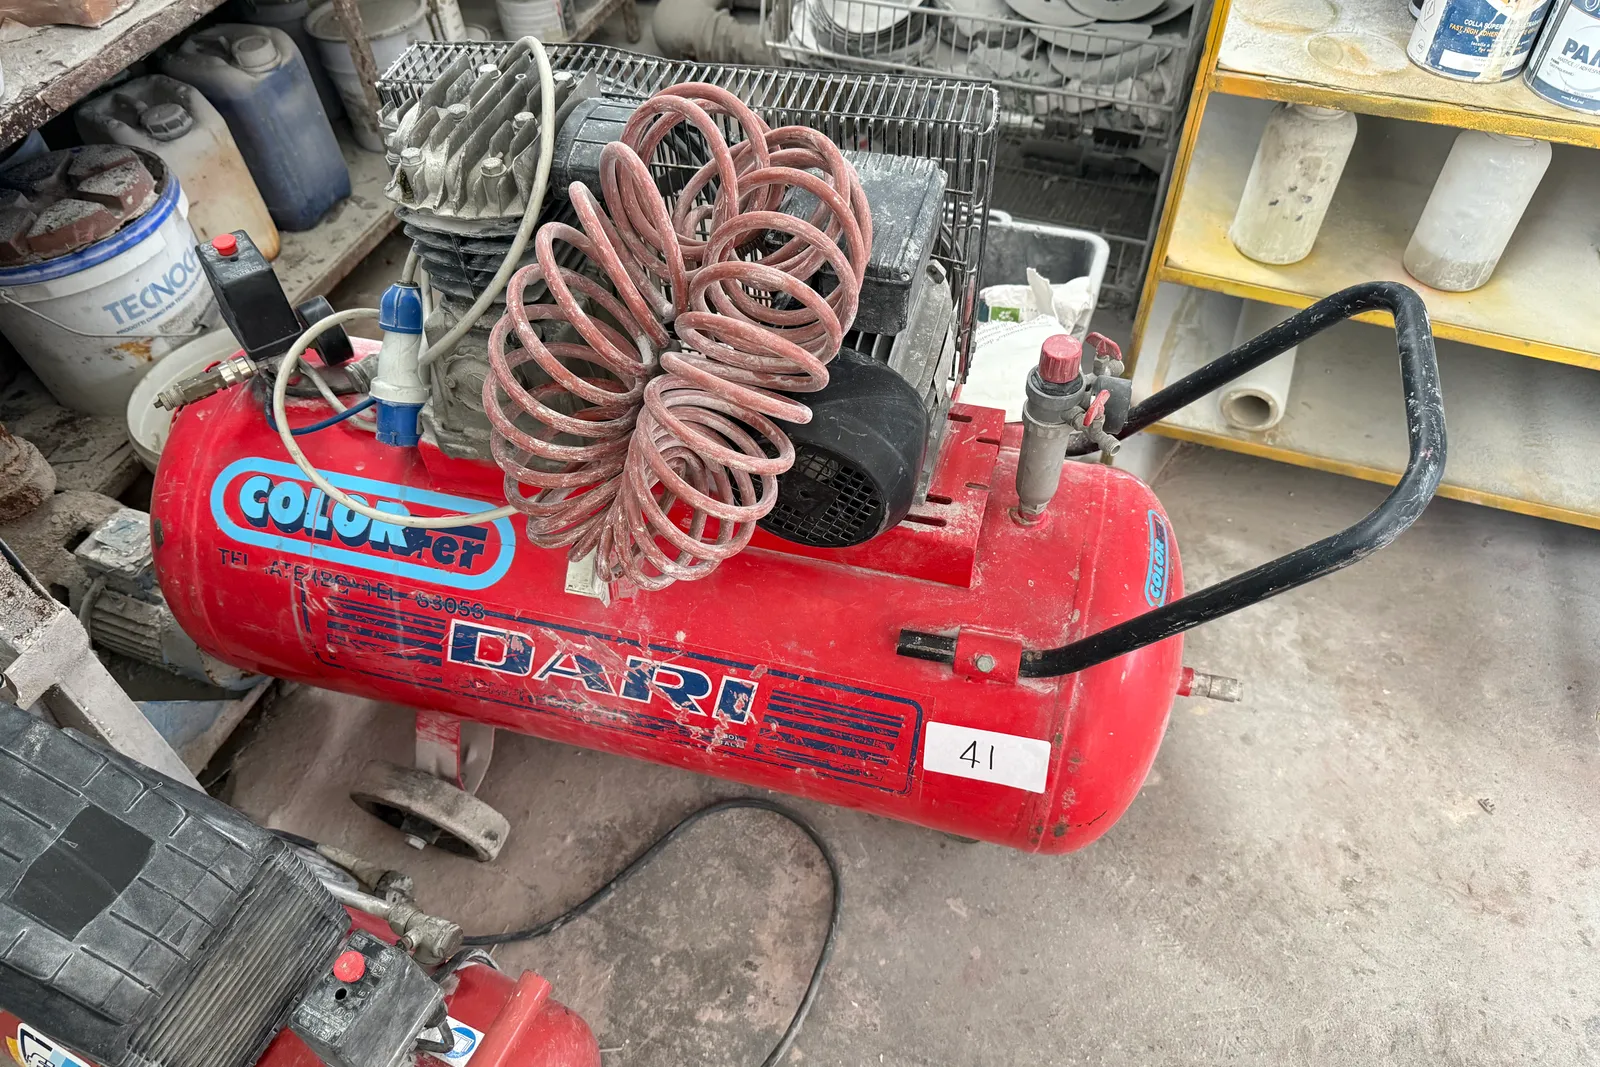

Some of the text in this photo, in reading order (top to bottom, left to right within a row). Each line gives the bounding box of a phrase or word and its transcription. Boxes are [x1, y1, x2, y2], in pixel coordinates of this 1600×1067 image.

[1463, 18, 1483, 28] COLLA
[446, 618, 759, 726] DARI
[959, 740, 995, 770] 41
